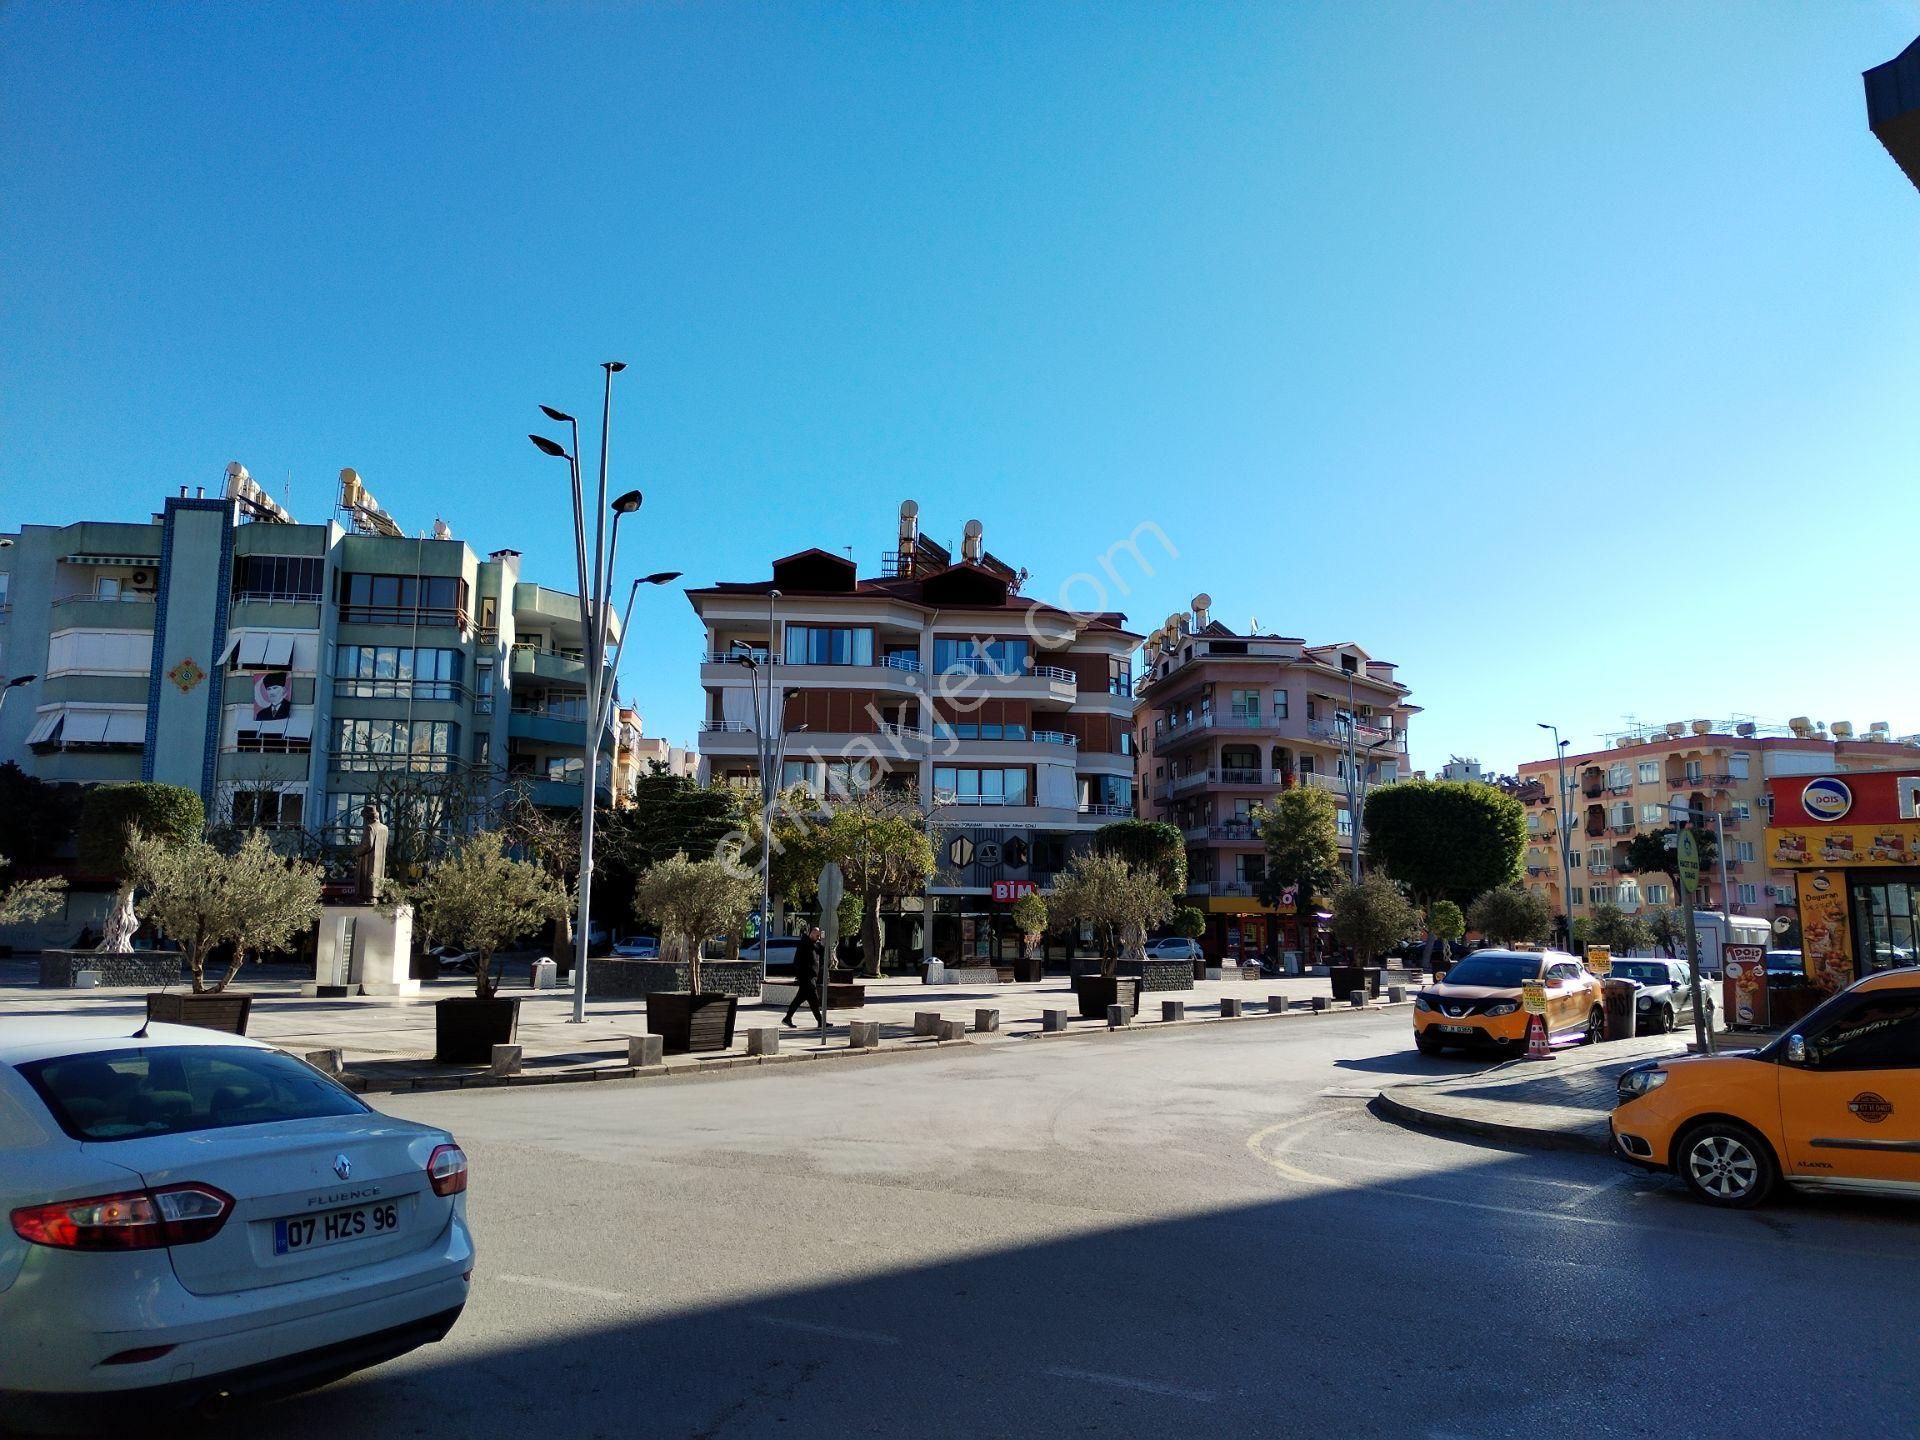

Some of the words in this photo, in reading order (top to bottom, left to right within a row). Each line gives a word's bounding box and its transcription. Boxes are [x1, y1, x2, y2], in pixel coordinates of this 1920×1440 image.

[996, 880, 1032, 899] BİM
[307, 1187, 381, 1206] FLUENCE
[288, 1219, 315, 1247] 07
[325, 1210, 366, 1240] HZS
[373, 1204, 397, 1230] 96
